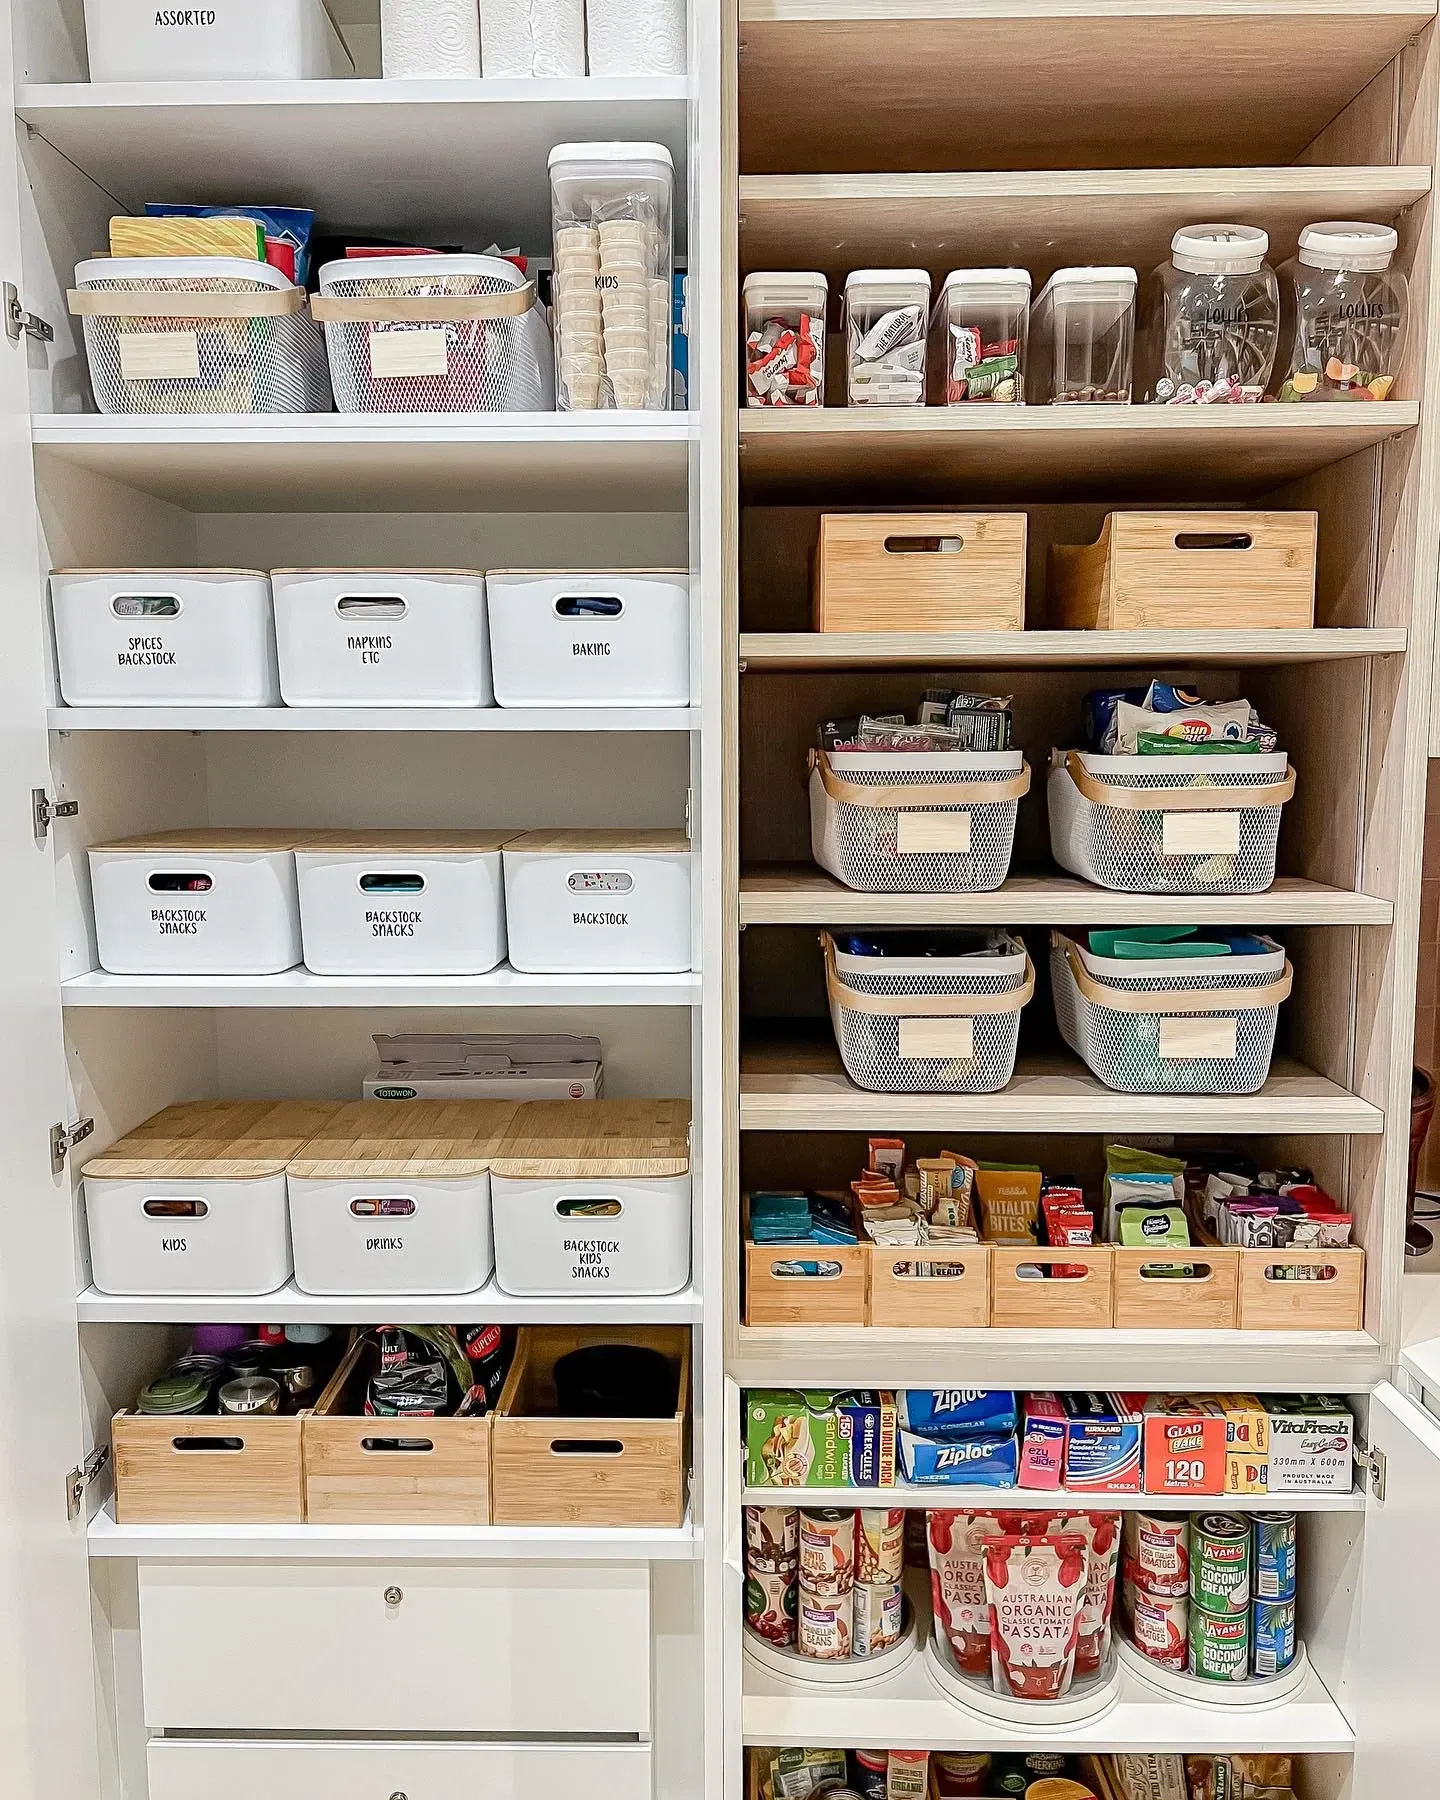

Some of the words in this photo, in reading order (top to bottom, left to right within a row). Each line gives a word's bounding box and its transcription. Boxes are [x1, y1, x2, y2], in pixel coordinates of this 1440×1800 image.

[154, 10, 216, 26] ASSORTED
[594, 276, 619, 291] KIDS
[1339, 303, 1384, 319] LOLLIES
[875, 339, 889, 353] THE
[884, 312, 911, 344] NATURAL
[128, 636, 163, 651] SPICES
[347, 636, 392, 650] NAPKINS
[572, 642, 611, 656] BAKING
[117, 652, 177, 666] BACKSTOCK
[362, 651, 380, 664] ETC
[151, 909, 207, 922] BACKSTOCK
[365, 910, 422, 924] BACKSTOCK
[572, 912, 629, 925] BACKSTOCK
[159, 922, 198, 935] SNACKS
[371, 923, 414, 937] SNACKS
[379, 1089, 413, 1098] TOTOWON
[988, 1199, 1037, 1216] VITALITY
[990, 1215, 1025, 1232] BITES
[162, 1238, 187, 1252] KIDS
[366, 1237, 403, 1251] DRINKS
[563, 1239, 620, 1253] BACKSTOCK
[579, 1252, 602, 1265] KIDS
[571, 1266, 610, 1279] SNACKS
[840, 1416, 851, 1438] 150
[880, 1411, 894, 1429] 150
[1167, 1424, 1203, 1438] GLAD
[1271, 1420, 1349, 1435] VitaFresh
[880, 1430, 894, 1458] VALUE
[1031, 1434, 1044, 1443] 30
[1172, 1437, 1202, 1450] BAKE
[825, 1415, 838, 1480] sandwich
[863, 1429, 874, 1480] HERCULES
[1028, 1447, 1049, 1458] ezy
[936, 1444, 993, 1469] Ziploc
[1030, 1456, 1056, 1467] slide
[1273, 1457, 1306, 1466] 330mm
[1320, 1457, 1345, 1466] 600m
[880, 1460, 894, 1484] PACK
[1165, 1460, 1205, 1480] 120
[1203, 1546, 1235, 1559] AYAM
[944, 1560, 983, 1569] AUSTRA
[944, 1571, 984, 1583] ORGA
[1201, 1567, 1246, 1585] COCONUT
[1201, 1579, 1233, 1596] CREAM
[944, 1589, 984, 1605] PASS
[1002, 1594, 1073, 1604] AUSTRALIAN
[1002, 1605, 1072, 1617] ORGANIC
[1002, 1617, 1036, 1625] CLASSIC
[1039, 1617, 1071, 1625] TOMATO
[1002, 1625, 1070, 1639] PASSATA
[1205, 1624, 1237, 1637] AYAM
[806, 1633, 832, 1647] BEANS
[1203, 1658, 1235, 1674] CREAM
